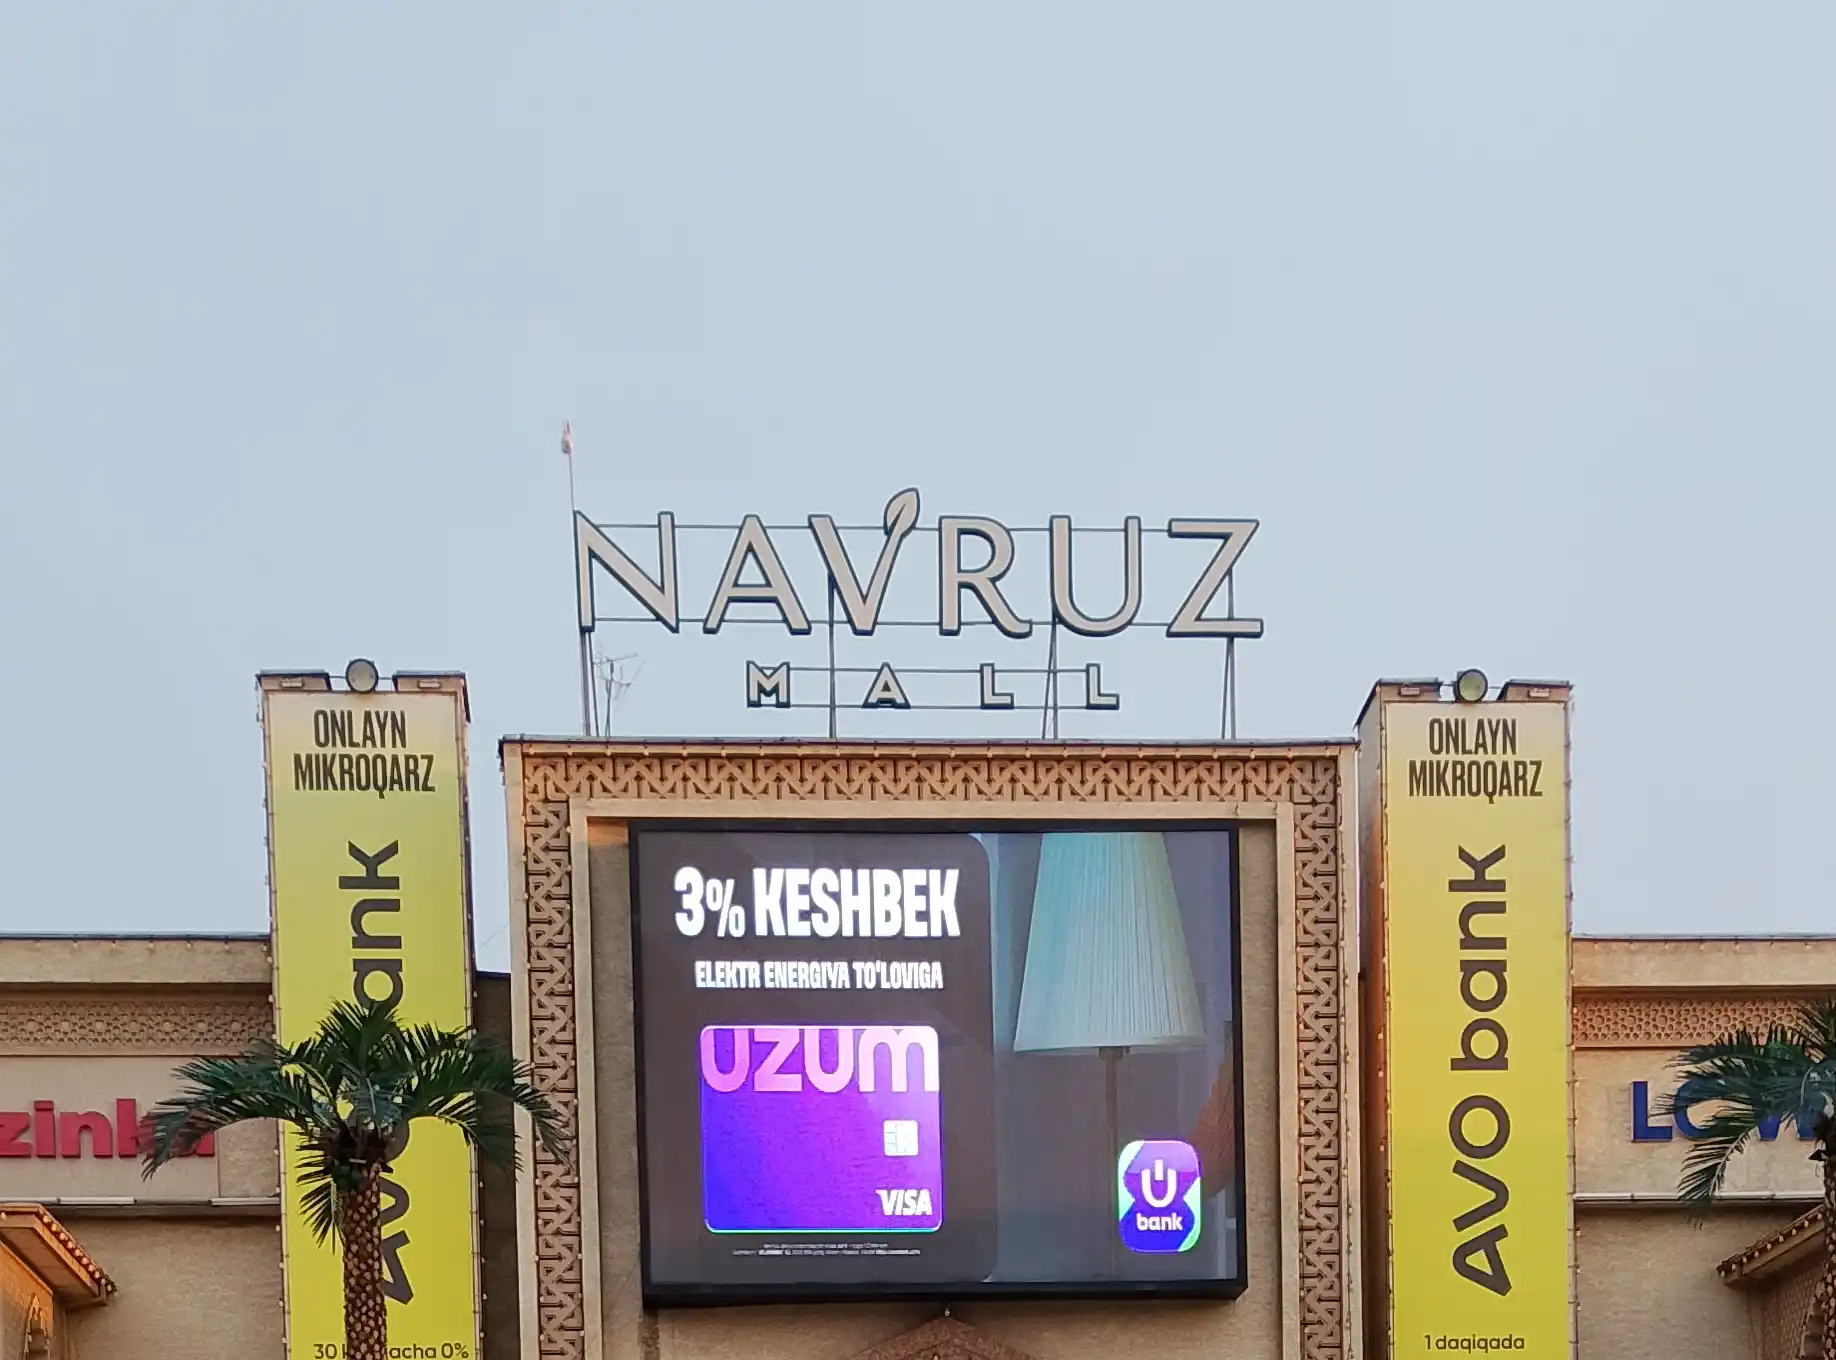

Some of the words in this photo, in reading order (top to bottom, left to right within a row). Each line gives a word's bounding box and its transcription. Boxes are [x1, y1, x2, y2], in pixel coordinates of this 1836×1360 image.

[573, 488, 1263, 638] NAVRUZ
[746, 660, 1119, 710] MALL
[313, 709, 407, 749] ONLAYN
[1428, 717, 1517, 756] ONLAYN
[294, 753, 436, 798] MIKROQARZ
[1408, 759, 1543, 804] MIKROQARZ
[674, 866, 745, 938] 3%
[753, 867, 960, 937] KESHBEK
[695, 961, 762, 989] ELEKTR
[763, 961, 851, 989] ENERGIYA
[1448, 844, 1510, 1071] bank
[876, 1188, 932, 1216] VISA
[1449, 1094, 1512, 1297] AVO
[1136, 1212, 1183, 1231] bank
[313, 1343, 338, 1360] 30
[441, 1342, 470, 1360] 0%
[1424, 1335, 1433, 1350] 1
[1435, 1333, 1525, 1354] daqiqada
